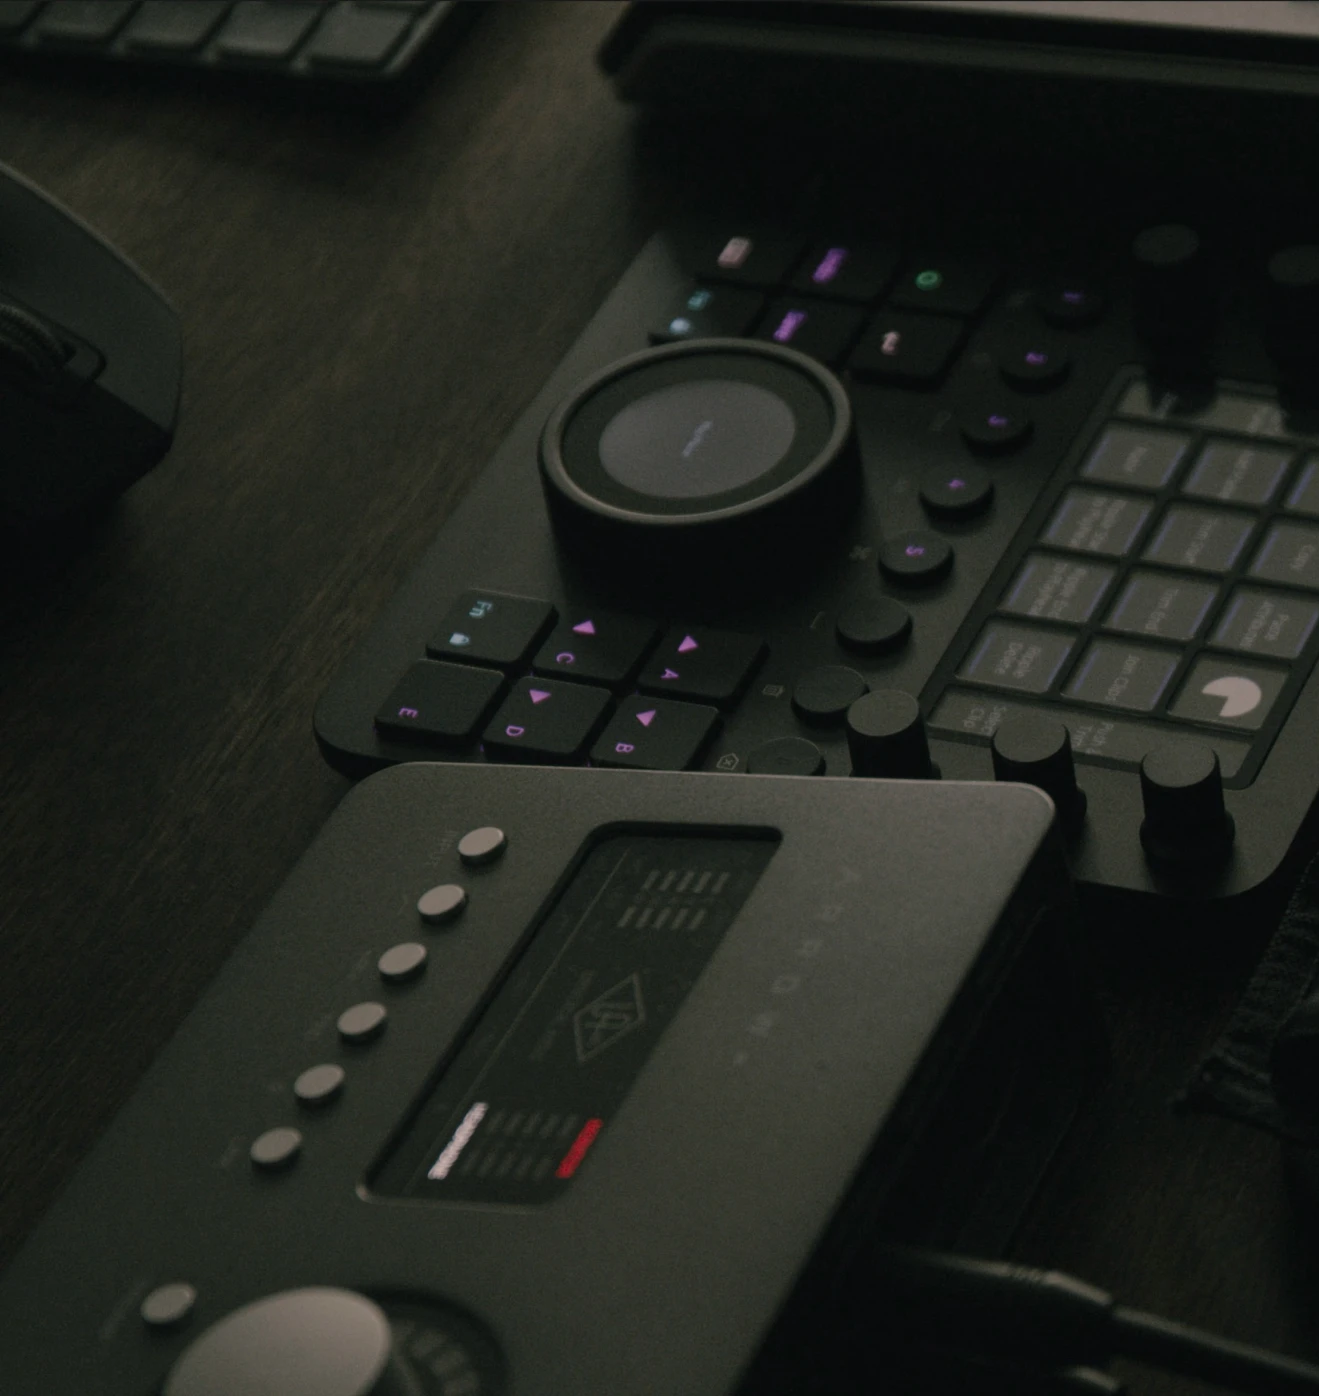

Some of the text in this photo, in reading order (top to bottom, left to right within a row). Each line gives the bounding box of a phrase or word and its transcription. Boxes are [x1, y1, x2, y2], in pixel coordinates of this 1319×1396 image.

[466, 600, 494, 619] Fn
[555, 650, 577, 665] C
[660, 668, 680, 680] A
[399, 706, 419, 719] E
[505, 724, 525, 738] D
[615, 741, 635, 755] B
